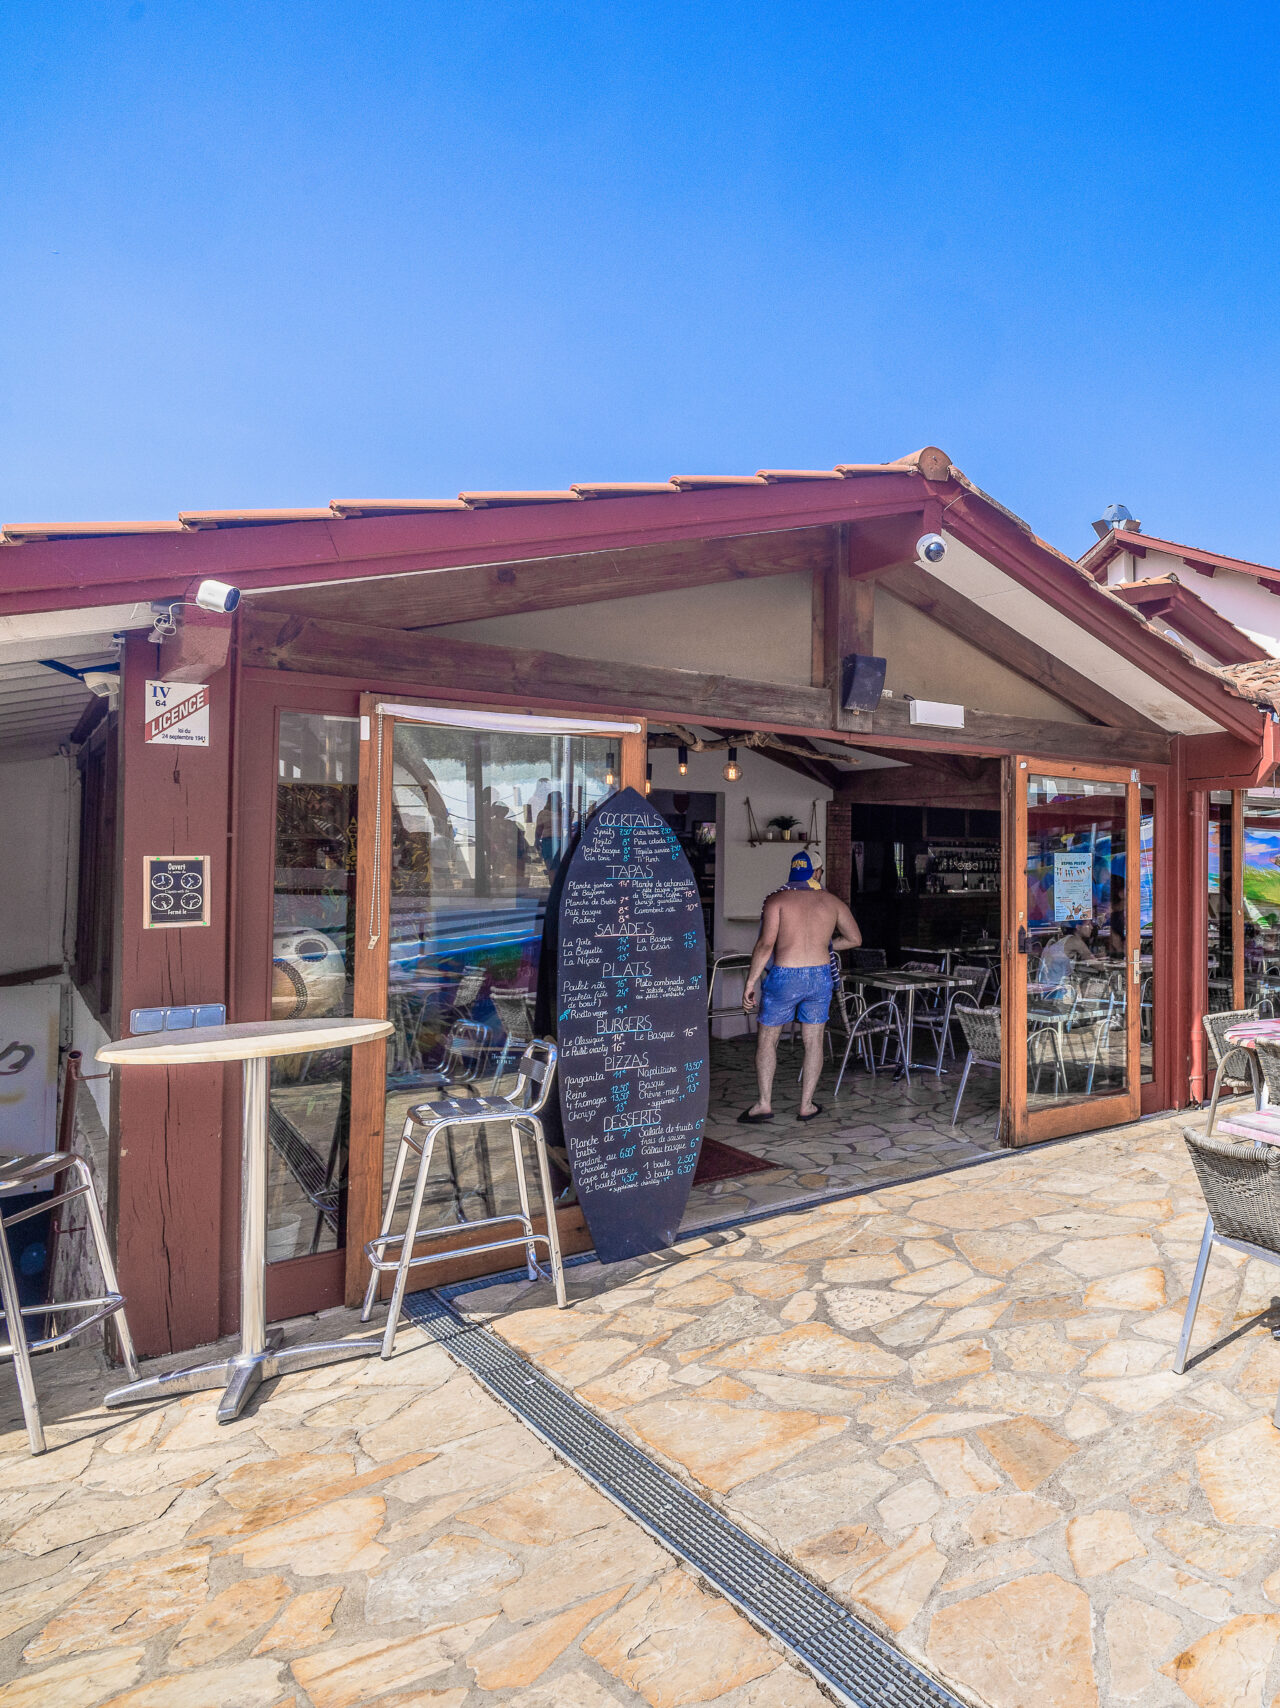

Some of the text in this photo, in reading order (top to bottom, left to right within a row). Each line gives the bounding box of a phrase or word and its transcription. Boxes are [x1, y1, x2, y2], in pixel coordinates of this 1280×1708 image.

[152, 686, 171, 699] IV
[155, 699, 167, 707] 64
[151, 691, 205, 736] LICENCE
[602, 846, 620, 857] basque
[605, 864, 654, 879] TAPAS
[568, 881, 591, 890] Planche
[593, 882, 614, 891] jambon
[631, 880, 653, 888] Planche
[565, 898, 589, 907] Planche
[582, 908, 602, 916] basque
[572, 916, 596, 925] Rabas
[595, 922, 655, 936] SALADES
[562, 938, 573, 947] La
[650, 935, 674, 944] Basque
[563, 949, 573, 957] La
[577, 957, 600, 967] Niçoise
[602, 961, 651, 977] PLATS
[563, 980, 588, 992] Poulet
[635, 977, 652, 987] Plato
[654, 976, 685, 986] combinado
[567, 1001, 576, 1009] de
[597, 1015, 652, 1034] BURGERS
[563, 1038, 573, 1047] Le
[575, 1035, 604, 1046] Classique
[634, 1031, 645, 1041] Le
[647, 1031, 676, 1042] Basque
[561, 1048, 570, 1057] Le
[565, 1071, 605, 1089] Margarita
[639, 1080, 665, 1091] Basque
[565, 1090, 587, 1101] Reine
[566, 1102, 572, 1110] 4
[574, 1096, 607, 1109] fromages
[568, 1109, 596, 1122] Chorizo
[604, 1109, 661, 1130] DESSERTS
[638, 1125, 665, 1138] Salade
[665, 1124, 674, 1134] de
[571, 1135, 599, 1150] Planche
[604, 1132, 615, 1142] de
[658, 1135, 666, 1143] de
[666, 1134, 686, 1142] saison
[575, 1147, 597, 1158] brebis
[664, 1143, 687, 1153] basque
[574, 1155, 602, 1169] Fondant
[643, 1161, 649, 1169] 1
[653, 1158, 671, 1169] boule
[581, 1162, 608, 1175] chocolat
[645, 1171, 652, 1180] 3
[654, 1168, 674, 1179] boules
[600, 1171, 610, 1179] de
[585, 1186, 594, 1194] 2
[594, 1179, 617, 1191] boules
